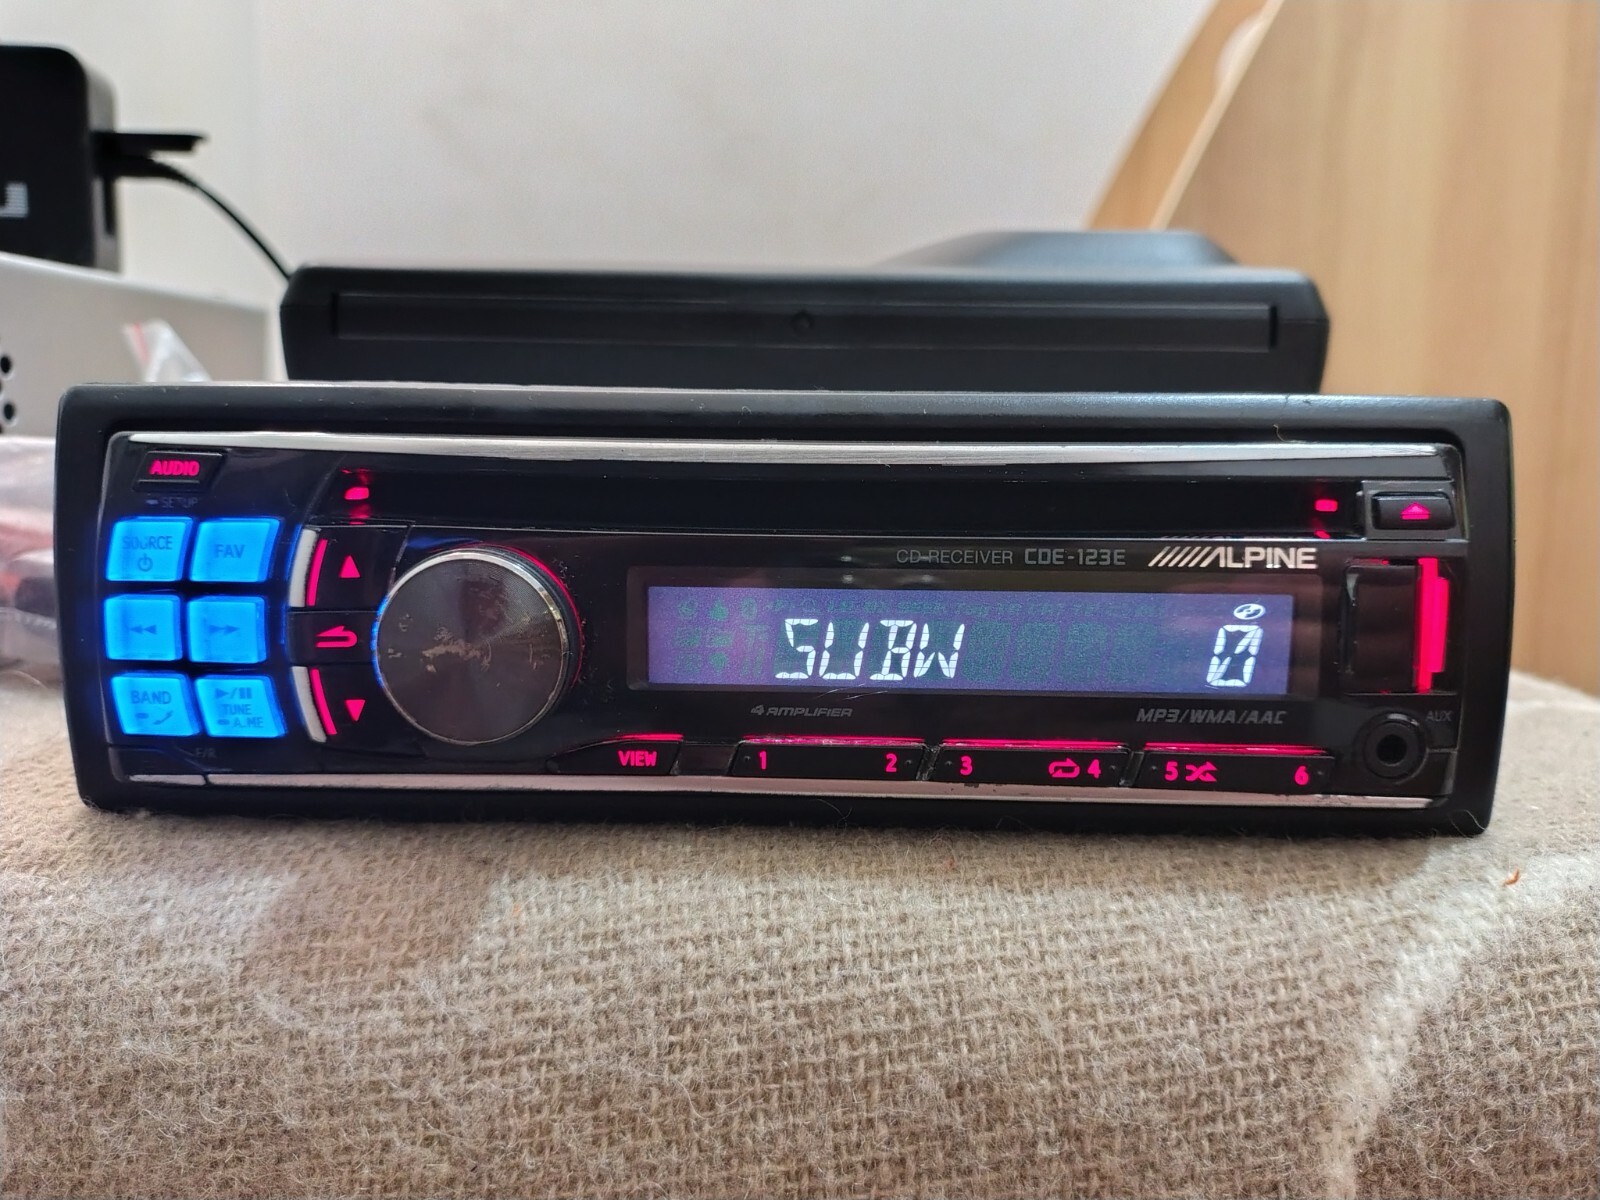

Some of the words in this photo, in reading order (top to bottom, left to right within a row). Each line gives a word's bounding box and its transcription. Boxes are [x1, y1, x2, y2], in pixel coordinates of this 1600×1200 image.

[151, 460, 200, 476] AUDIO
[161, 496, 198, 508] SETUP
[122, 535, 173, 550] SOURCE
[215, 543, 246, 559] FAV
[896, 549, 1014, 565] CD-RECEIVER
[1024, 548, 1126, 566] CDE-123E
[775, 618, 965, 681] SUBW
[1206, 624, 1264, 687] 0
[130, 690, 172, 704] BAND
[219, 703, 252, 715] TUNE
[766, 707, 854, 717] AMPLIFIER
[1136, 708, 1288, 725] MP3/WMA/AAC
[1425, 710, 1454, 722] AUX
[618, 750, 658, 767] VIEW
[759, 751, 768, 770] 1
[885, 753, 898, 772] 2
[960, 755, 974, 776] 3
[1087, 759, 1102, 779] 4
[1164, 761, 1179, 781] 5
[1294, 765, 1309, 786] 6
